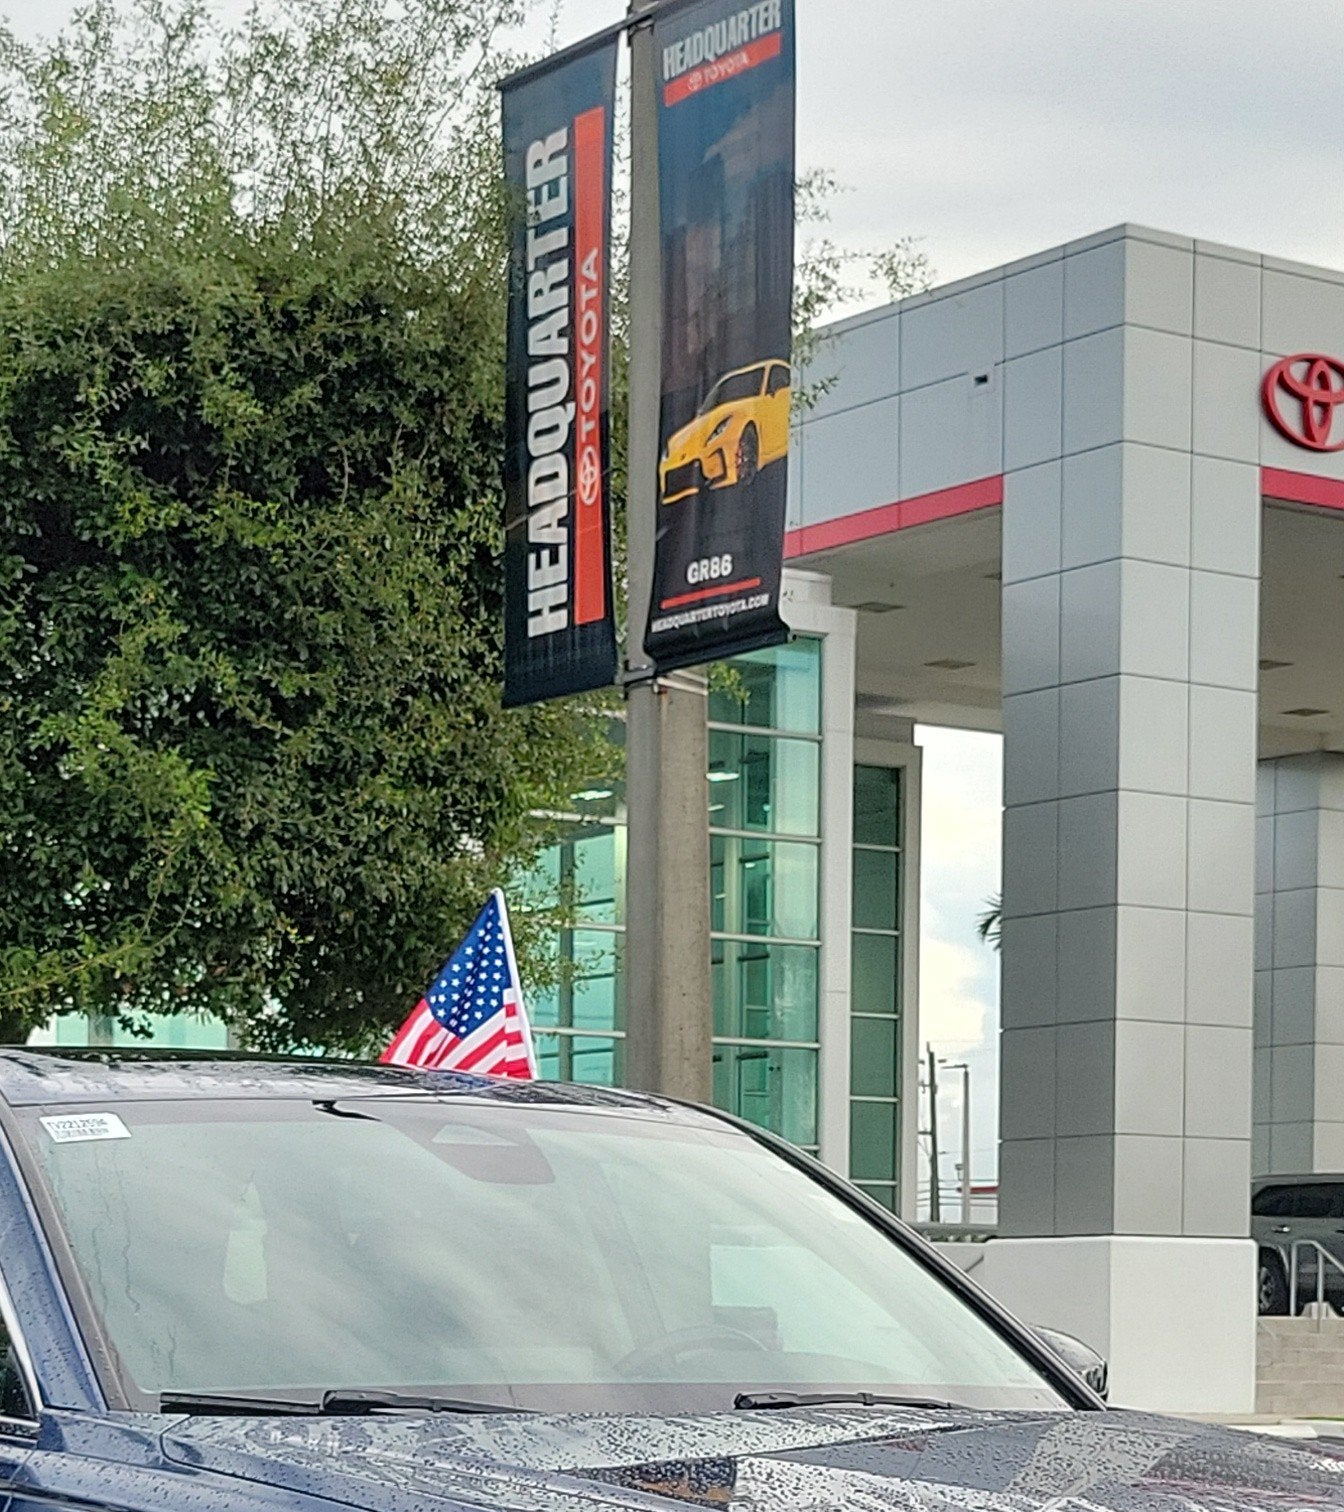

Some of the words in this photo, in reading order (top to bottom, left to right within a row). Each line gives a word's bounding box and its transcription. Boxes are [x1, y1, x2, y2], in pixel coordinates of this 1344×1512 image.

[662, 0, 781, 81] HEADQUARTER
[527, 126, 576, 638] HEADQUARTER
[579, 248, 598, 442] TOYOTA
[687, 553, 733, 585] GR86
